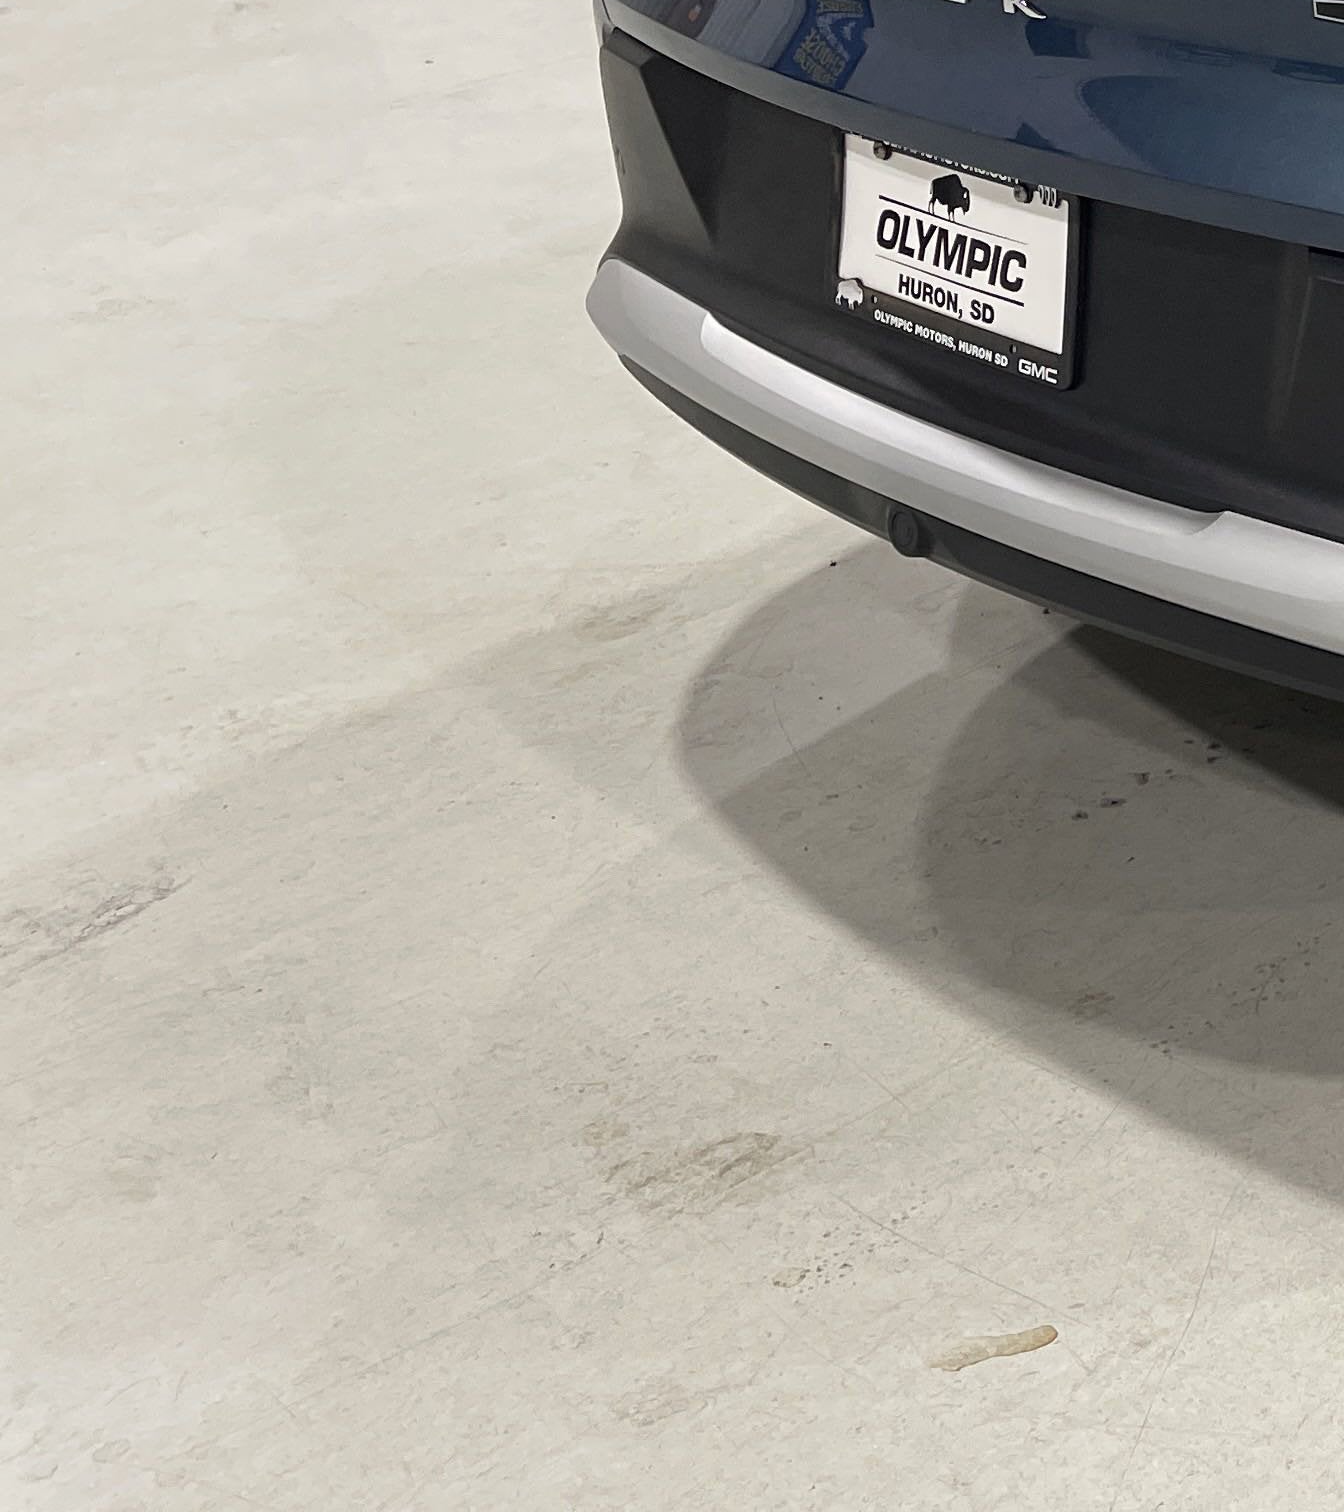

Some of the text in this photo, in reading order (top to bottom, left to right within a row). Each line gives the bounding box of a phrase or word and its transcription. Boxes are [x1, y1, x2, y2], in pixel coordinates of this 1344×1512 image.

[876, 208, 1028, 294] OLYMPIC
[898, 273, 995, 325] HURON, SD
[873, 308, 1009, 368] OLYMPIC MOTORS, HURON SD
[1018, 358, 1058, 385] GMC
